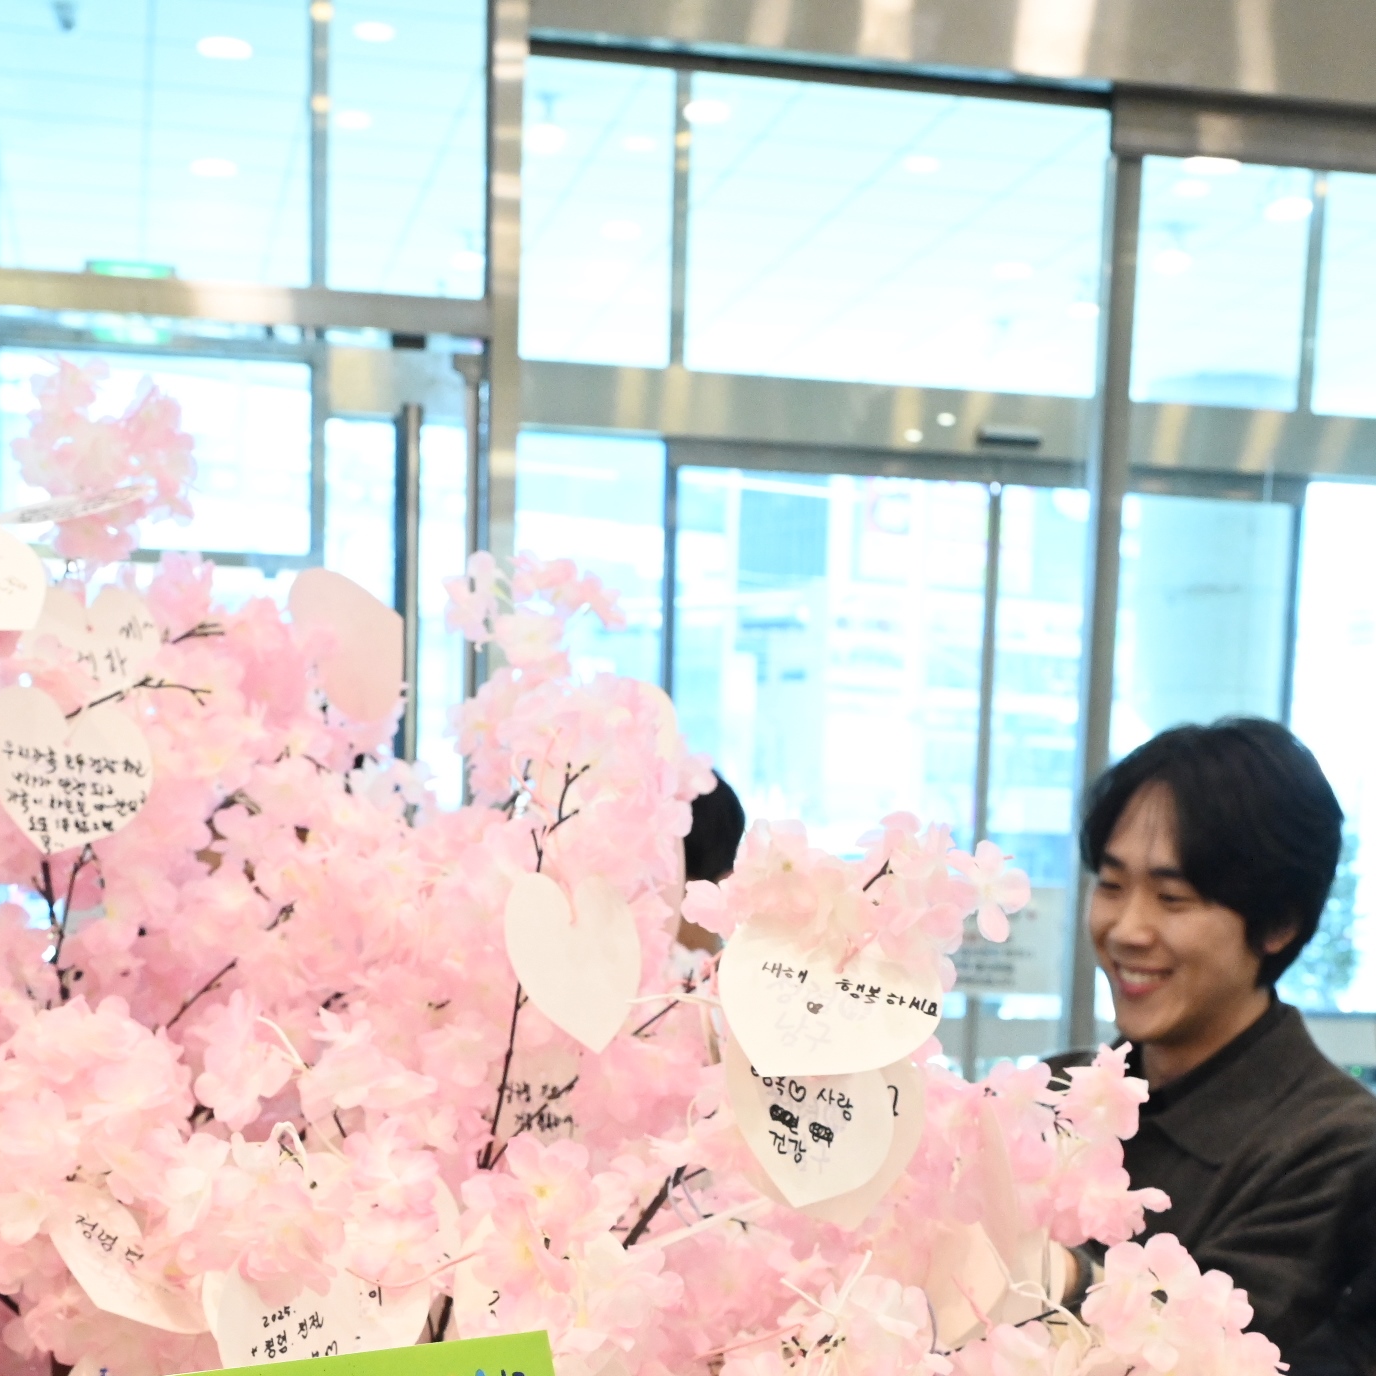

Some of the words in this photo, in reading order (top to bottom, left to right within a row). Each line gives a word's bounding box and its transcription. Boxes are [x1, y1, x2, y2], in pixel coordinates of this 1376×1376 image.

[761, 961, 809, 985] 새해
[817, 1088, 855, 1123] 사랑
[769, 1129, 808, 1165] 건강
